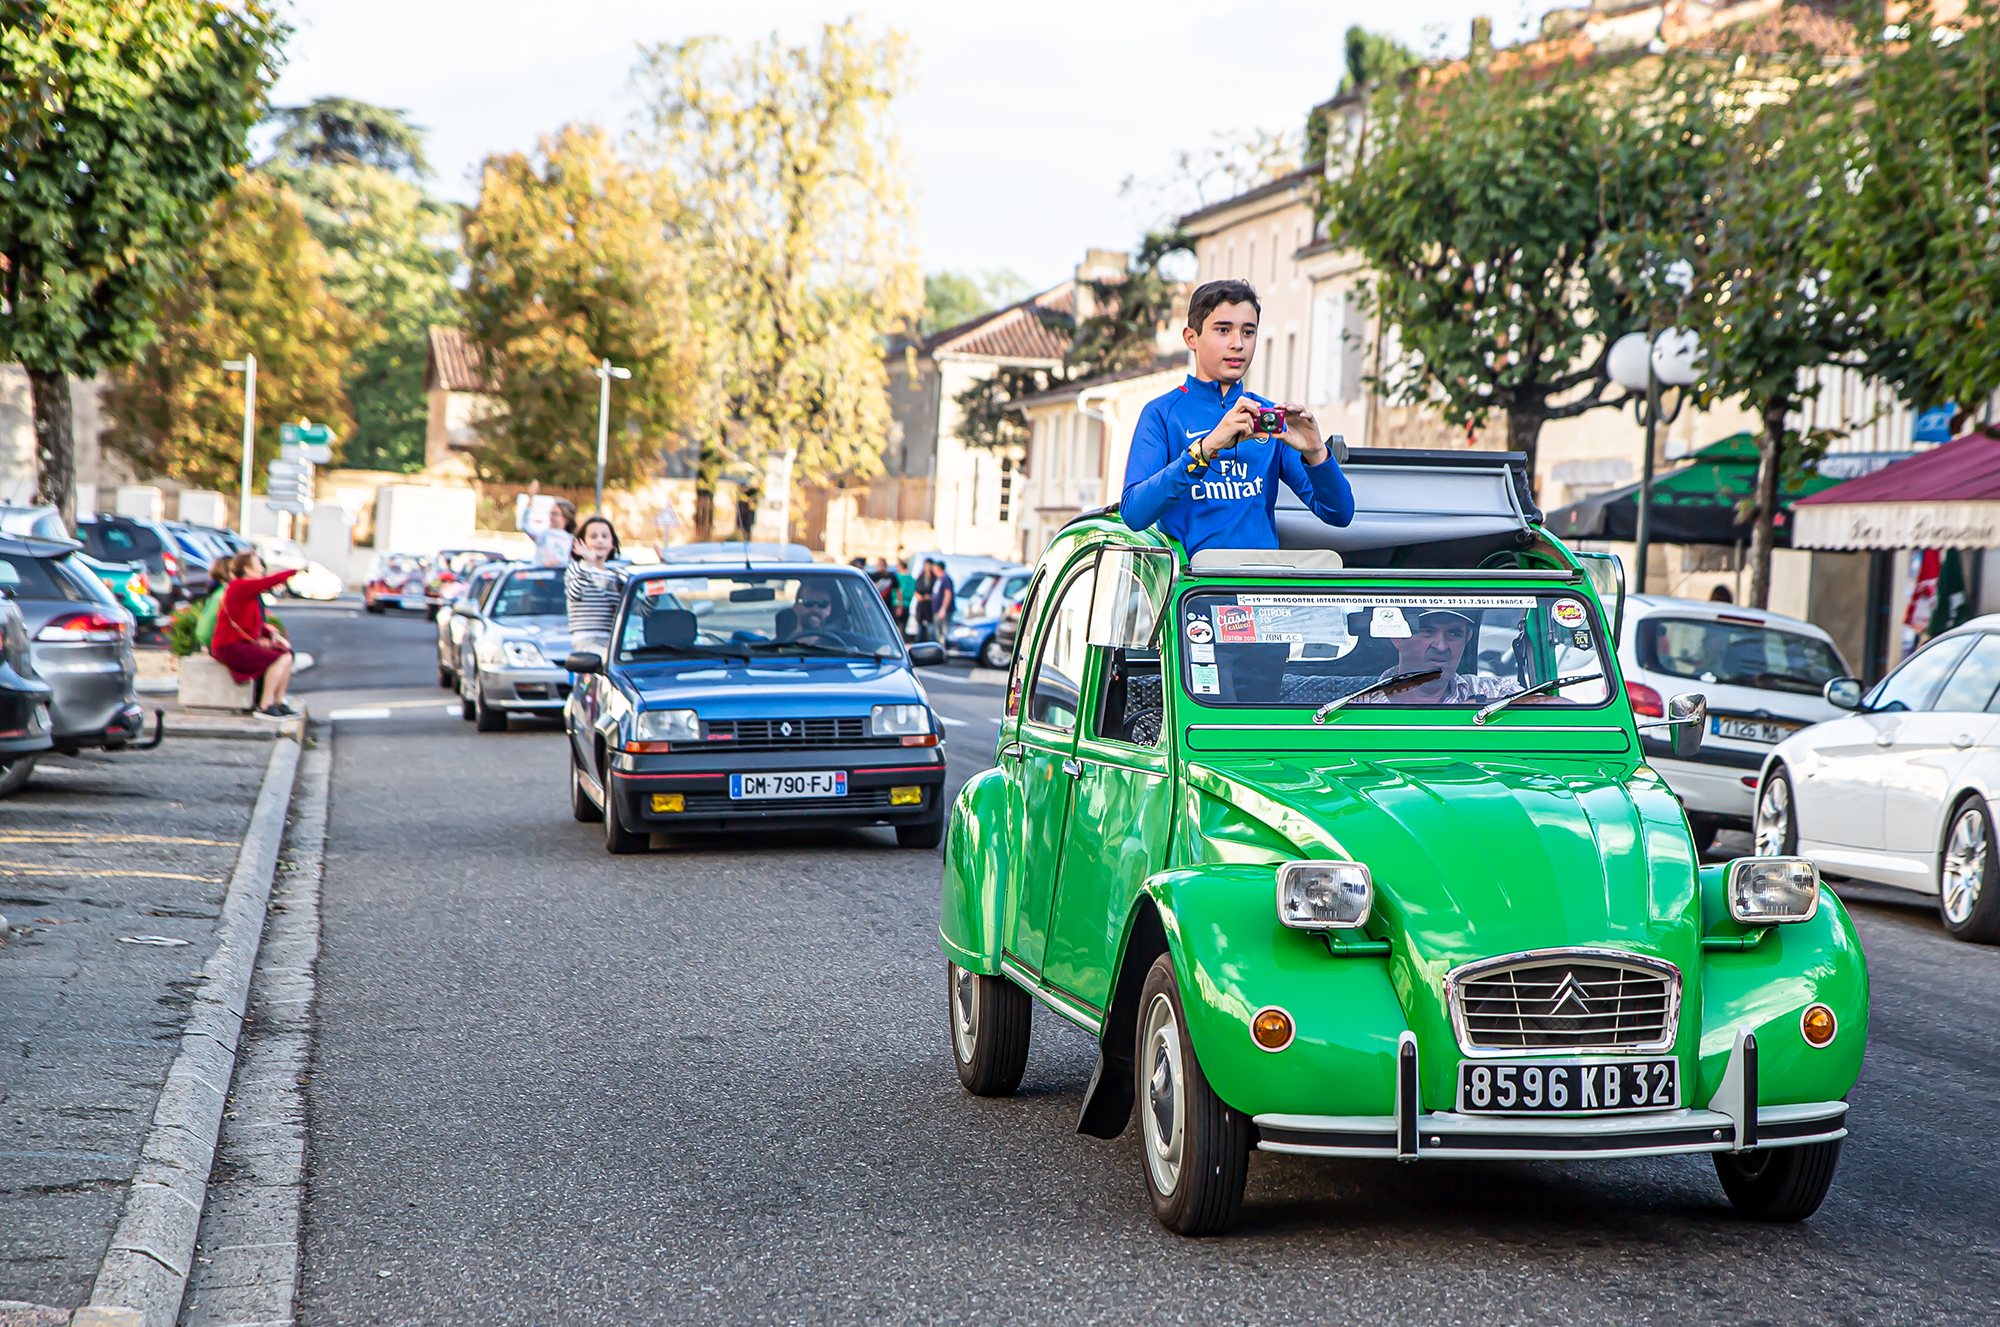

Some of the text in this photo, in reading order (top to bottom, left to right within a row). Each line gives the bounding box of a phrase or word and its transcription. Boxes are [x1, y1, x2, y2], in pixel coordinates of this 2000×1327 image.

[1219, 459, 1248, 480] Fly
[1216, 610, 1256, 627] Classic
[1223, 621, 1252, 632] Festival
[1265, 633, 1283, 641] ZONE
[744, 775, 833, 795] DM-790-FJ
[836, 784, 844, 793] 31
[1471, 1063, 1670, 1108] 8596 KB 32
